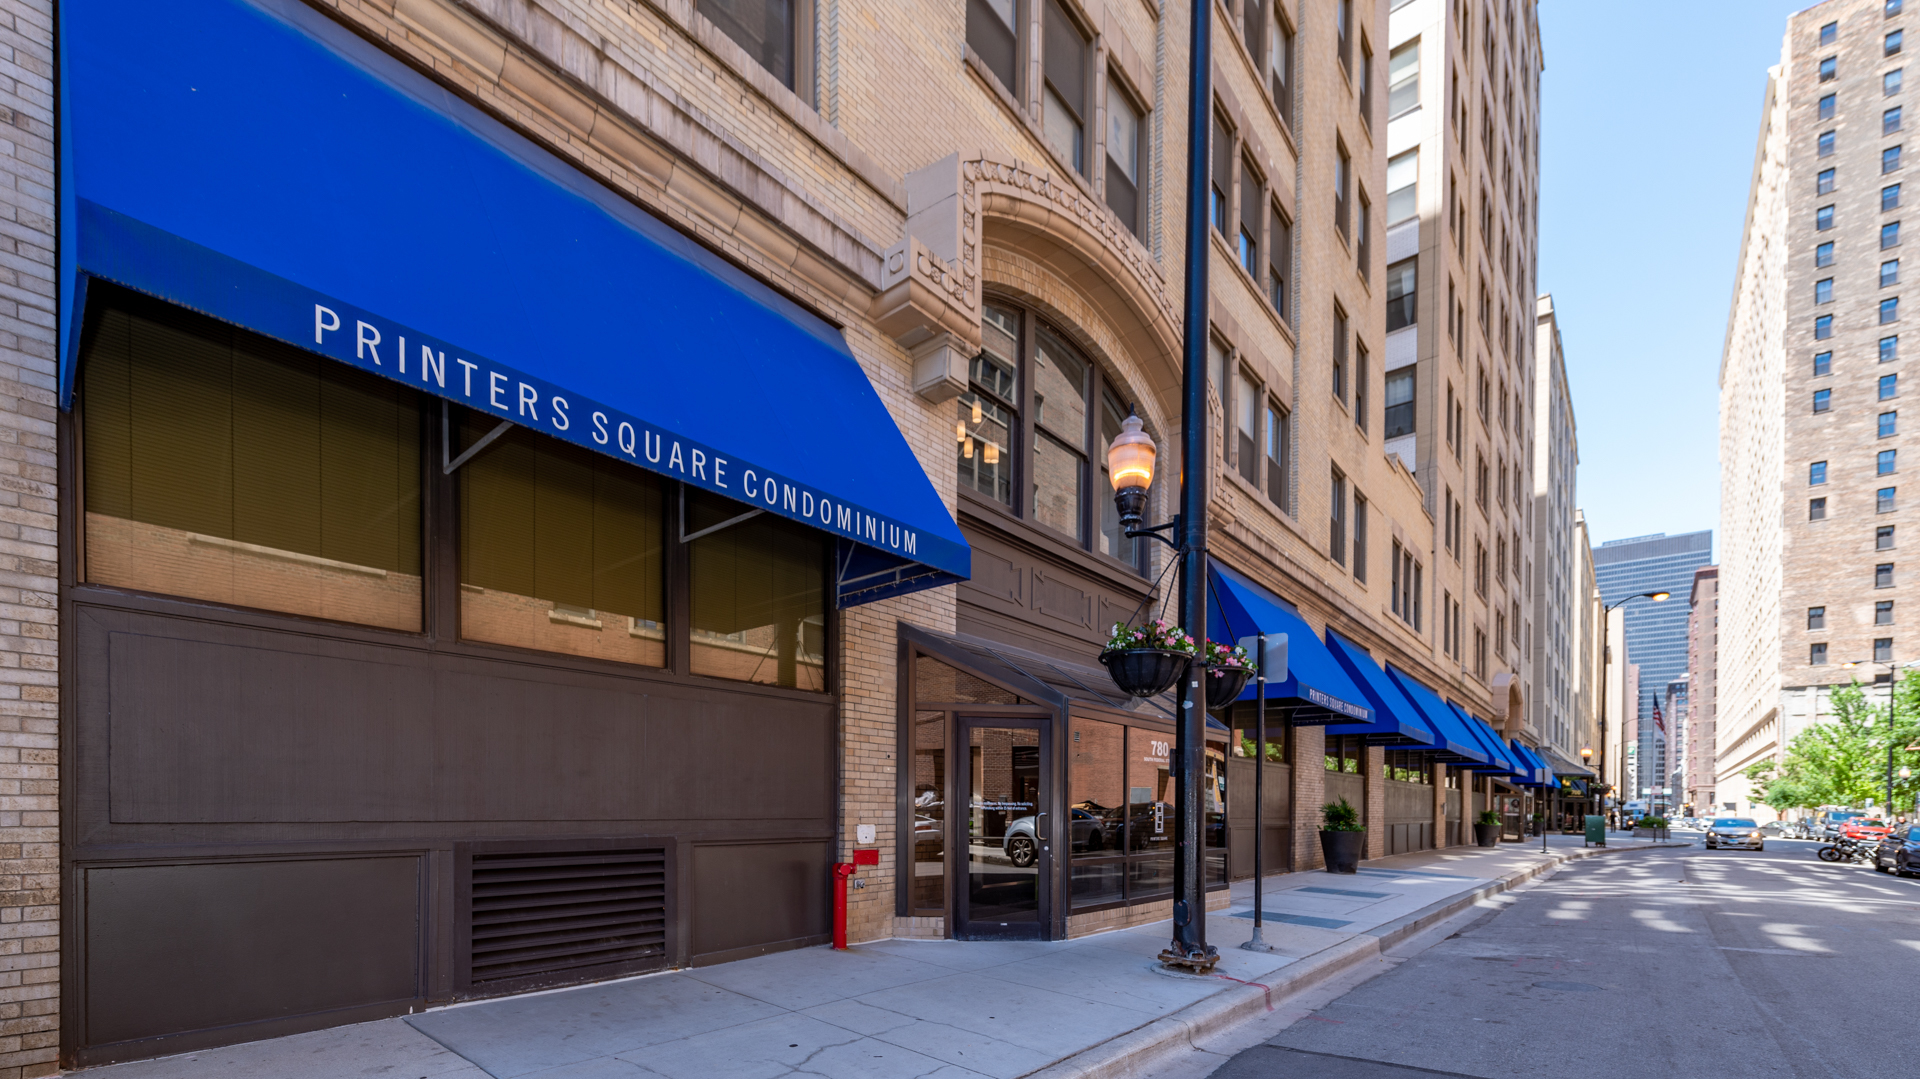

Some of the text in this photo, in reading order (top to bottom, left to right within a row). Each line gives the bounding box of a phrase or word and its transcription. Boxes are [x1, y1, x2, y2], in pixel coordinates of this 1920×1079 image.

[314, 303, 917, 556] PRINTERS SQUARE CONDOMINIUM
[1309, 688, 1368, 719] PRINTERS SQUARE CONDOMINIUM
[1150, 740, 1169, 757] 780
